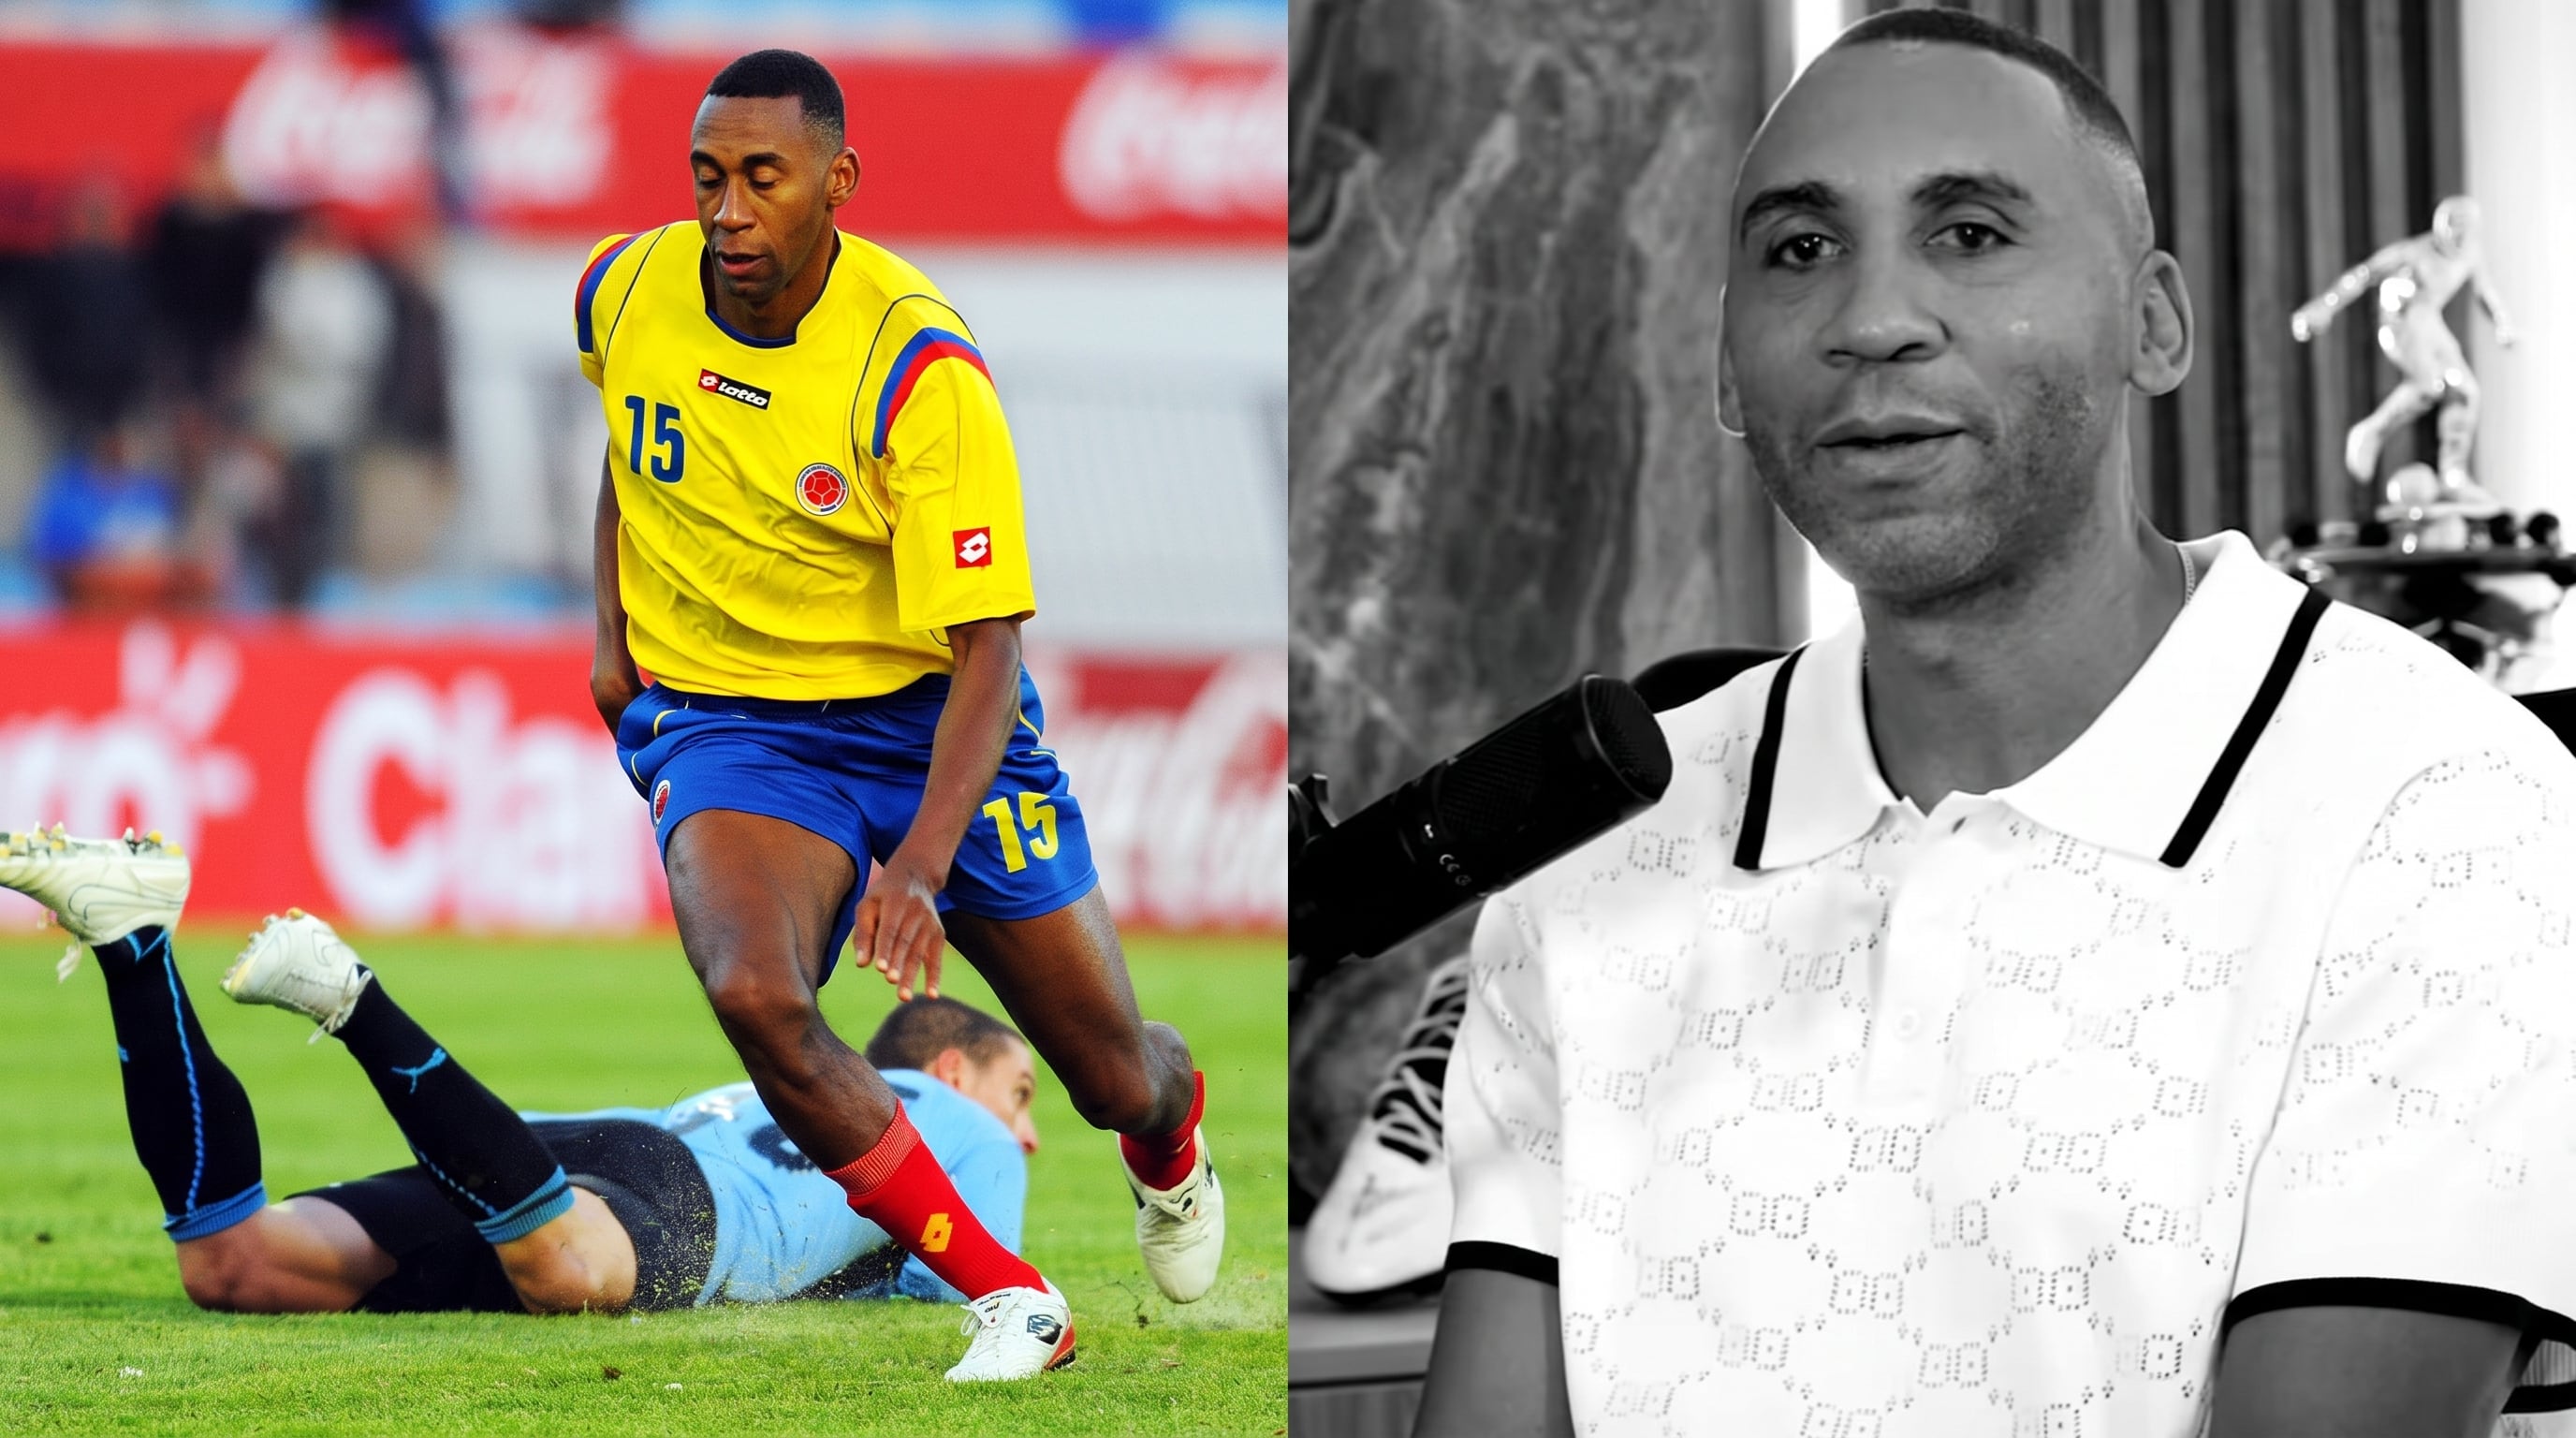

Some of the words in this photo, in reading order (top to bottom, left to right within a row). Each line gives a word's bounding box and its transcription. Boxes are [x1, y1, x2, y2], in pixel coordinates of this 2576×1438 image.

[624, 394, 685, 484] 15
[307, 668, 651, 936] Clar
[982, 791, 1059, 873] 15
